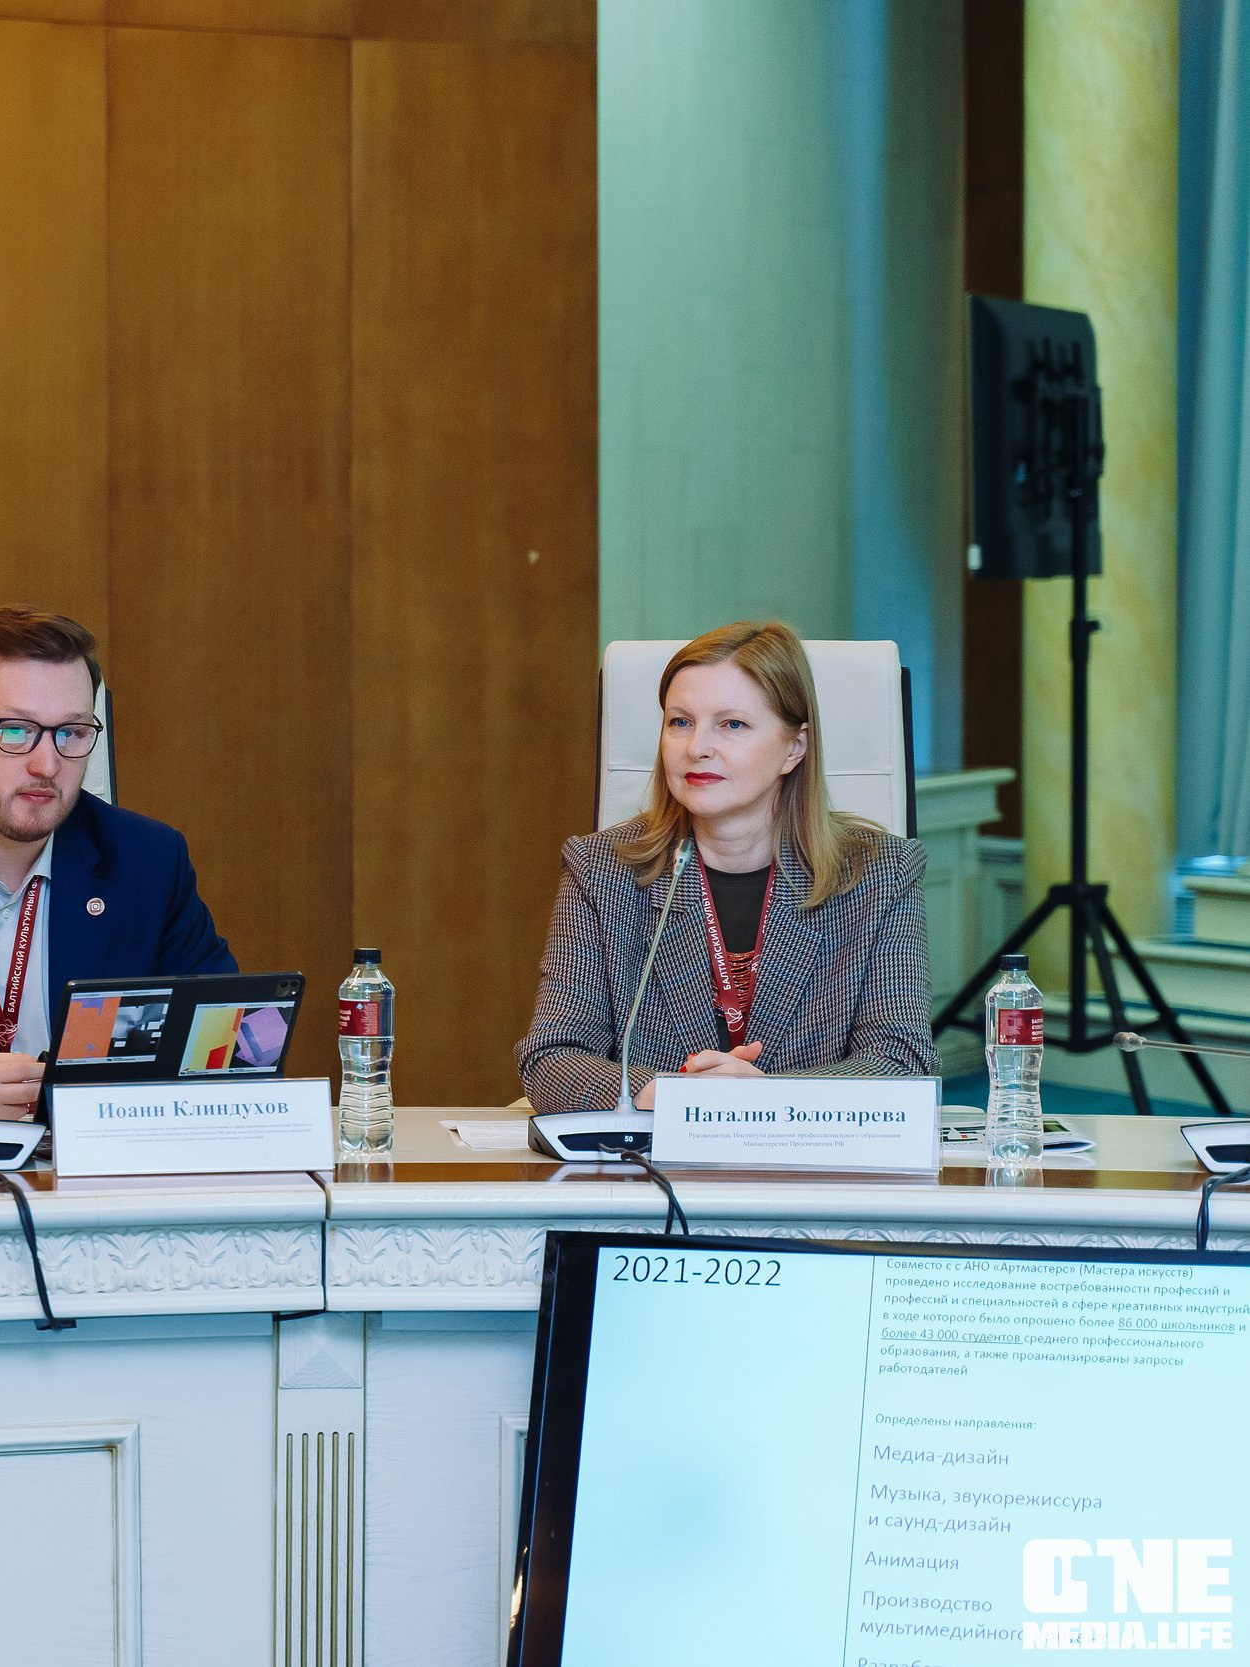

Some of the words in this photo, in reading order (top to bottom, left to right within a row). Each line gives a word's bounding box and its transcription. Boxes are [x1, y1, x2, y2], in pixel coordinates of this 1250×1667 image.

[8, 950, 25, 1013] БАЛТИЙСКИЙ
[19, 890, 36, 950] КУЛЬТУРНЫЙ
[708, 926, 731, 991] БАЛТИЙСКИЙ
[98, 1102, 166, 1119] Иоанн
[173, 1100, 290, 1120] Клиндухов
[684, 1106, 776, 1123] Наталия
[784, 1106, 906, 1127] Золотарева
[624, 1135, 634, 1143] 50
[613, 1255, 781, 1286] 2021-2022
[886, 1258, 942, 1270] Совместо
[964, 1261, 990, 1272] АНО
[994, 1262, 1076, 1275] «Артмастерс»
[1080, 1264, 1134, 1278] (Мастера
[1138, 1266, 1194, 1280] искусств)
[885, 1277, 950, 1288] проведено
[954, 1279, 1036, 1291] исследование
[1040, 1282, 1150, 1294] востребованности
[1154, 1285, 1219, 1298] профессий
[884, 1293, 948, 1306] профессий
[962, 1298, 1058, 1309] специальностей
[1072, 1300, 1108, 1312] сфере
[1112, 1302, 1182, 1313] креативных
[1186, 1304, 1250, 1316] индустрий
[892, 1312, 920, 1322] ходе
[923, 1314, 976, 1325] которого
[980, 1312, 1010, 1324] было
[1014, 1316, 1076, 1326] опрошено
[1079, 1316, 1114, 1328] более
[1118, 1318, 1132, 1328] 86
[1136, 1318, 1158, 1330] 000
[1161, 1322, 1235, 1332] школьников
[882, 1327, 916, 1339] более
[920, 1328, 934, 1340] 43
[937, 1329, 959, 1340] 000
[962, 1332, 1020, 1343] студентов
[1024, 1335, 1078, 1346] среднего
[1082, 1336, 1204, 1348] профессионального
[880, 1344, 960, 1359] образования,
[974, 1350, 1008, 1360] также
[1012, 1352, 1129, 1364] проанализированы
[1133, 1357, 1184, 1368] запросы
[878, 1362, 968, 1376] работодателей
[875, 1413, 950, 1426] Определены
[954, 1417, 1036, 1430] направления:
[874, 1445, 1009, 1466] Медиа-дизайн
[870, 1484, 946, 1506] Музыка,
[952, 1490, 1102, 1512] звукорежиссура
[868, 1515, 878, 1527] и
[884, 1516, 1011, 1533] саунд-дизайн
[864, 1550, 960, 1572] Анимация
[862, 1590, 992, 1613] Производство
